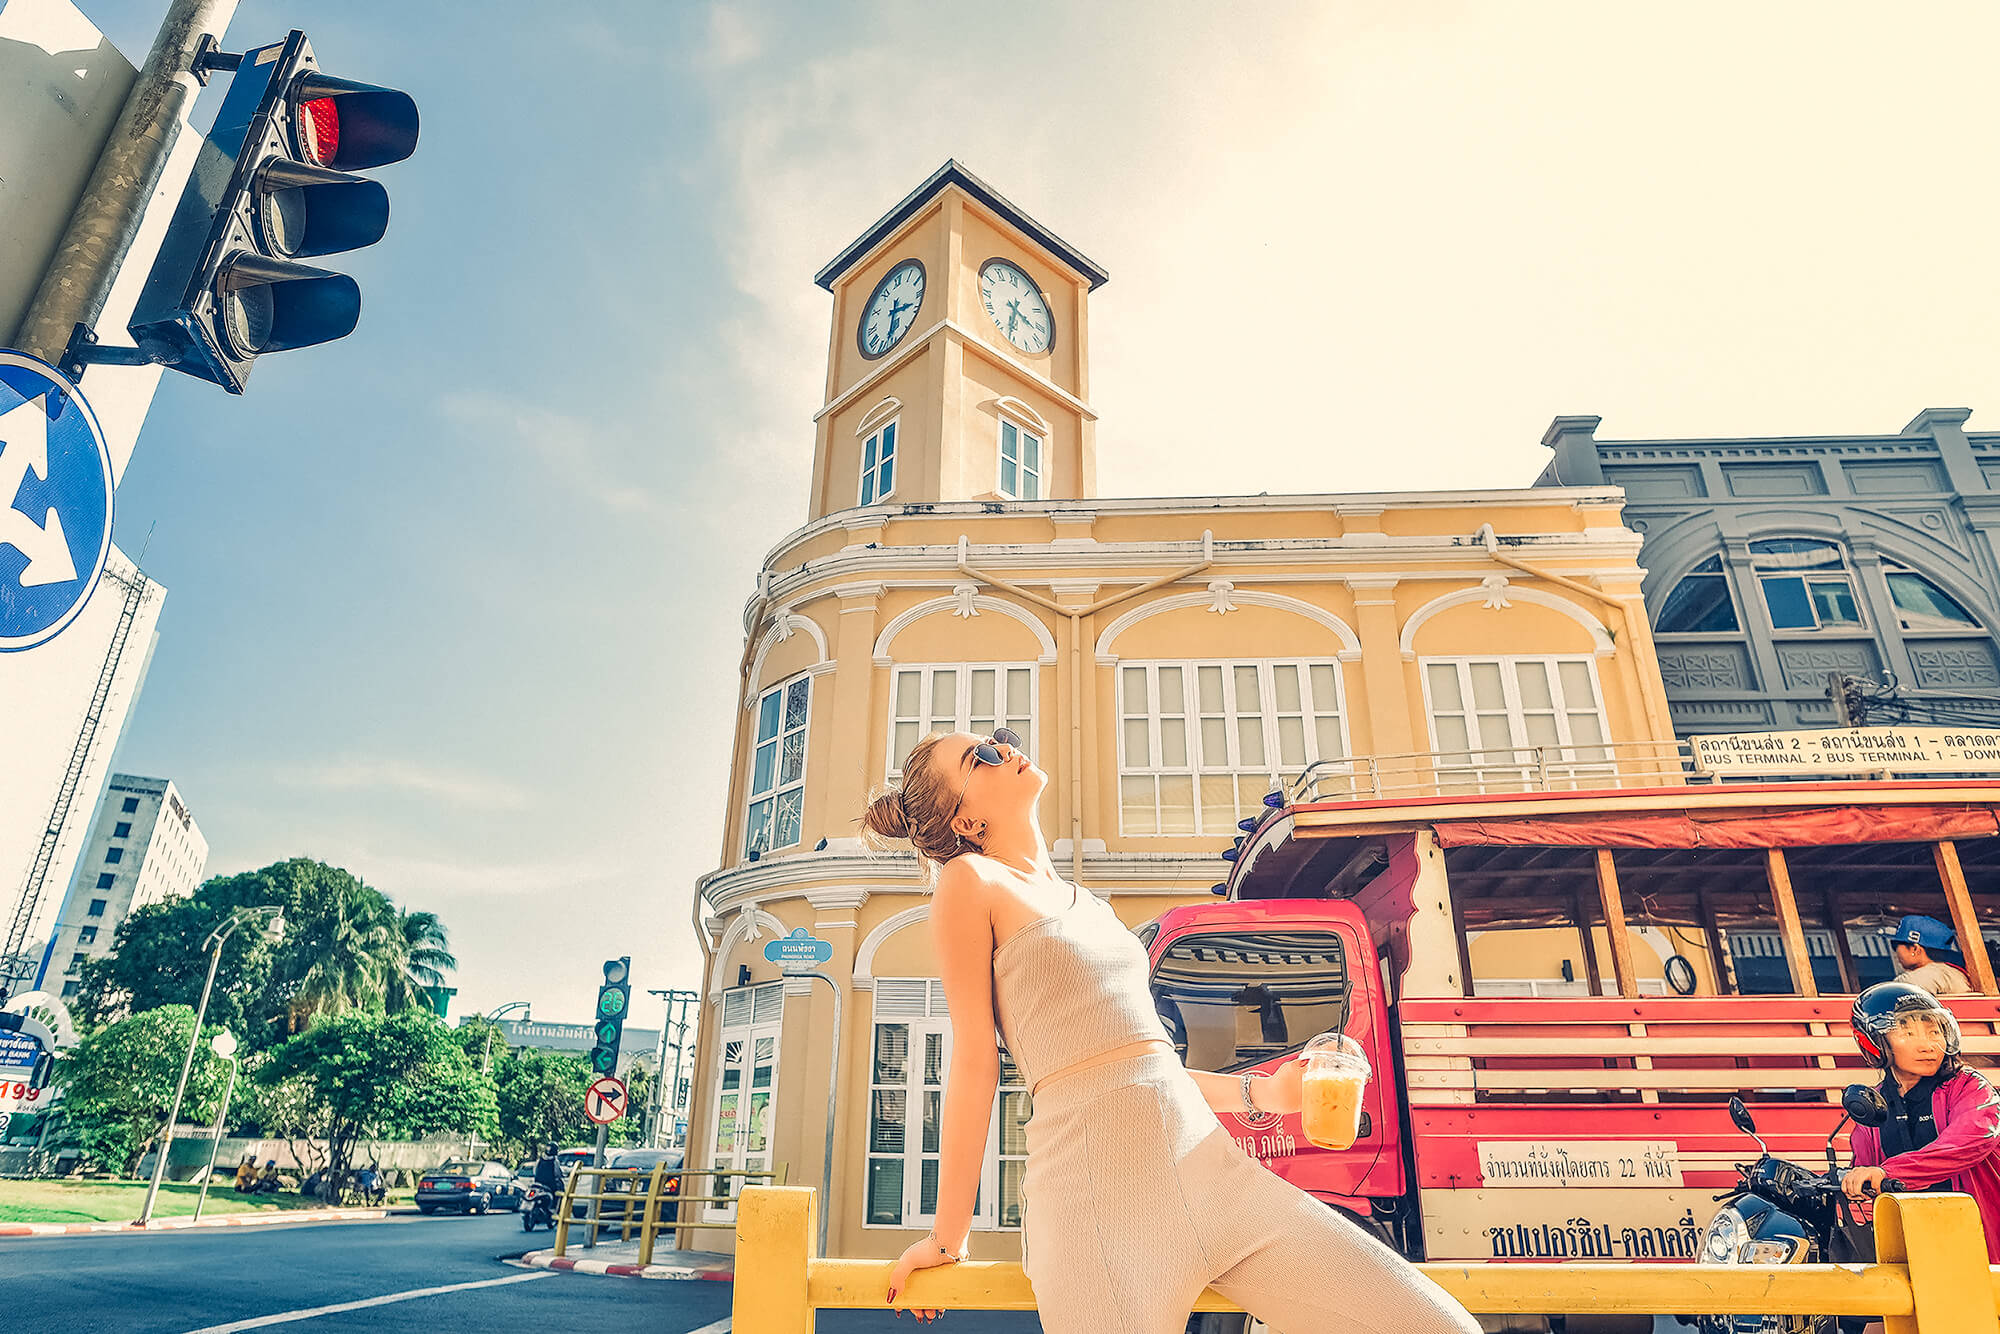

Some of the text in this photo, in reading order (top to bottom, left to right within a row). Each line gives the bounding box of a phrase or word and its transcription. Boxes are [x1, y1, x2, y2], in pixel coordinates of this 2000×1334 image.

[1700, 733, 1784, 751] สถานีขนส่ง
[1791, 738, 1801, 750] 2
[1820, 730, 1906, 749] สถานีขนส่ง
[1914, 736, 1921, 748] 1
[1704, 753, 1732, 765] BUS
[1736, 752, 1807, 765] TERMINAL
[1812, 753, 1821, 763] 2
[1827, 752, 1855, 763] BUS
[1860, 750, 1930, 762] TERMINAL
[1936, 750, 1943, 761] 1
[601, 991, 623, 1012] 26
[1231, 1120, 1296, 1167] บจ.ภูเก็ต
[1486, 1145, 1673, 1186] จำนวนที่นั่งผู้โดยสาร 22 ที่นั่ง
